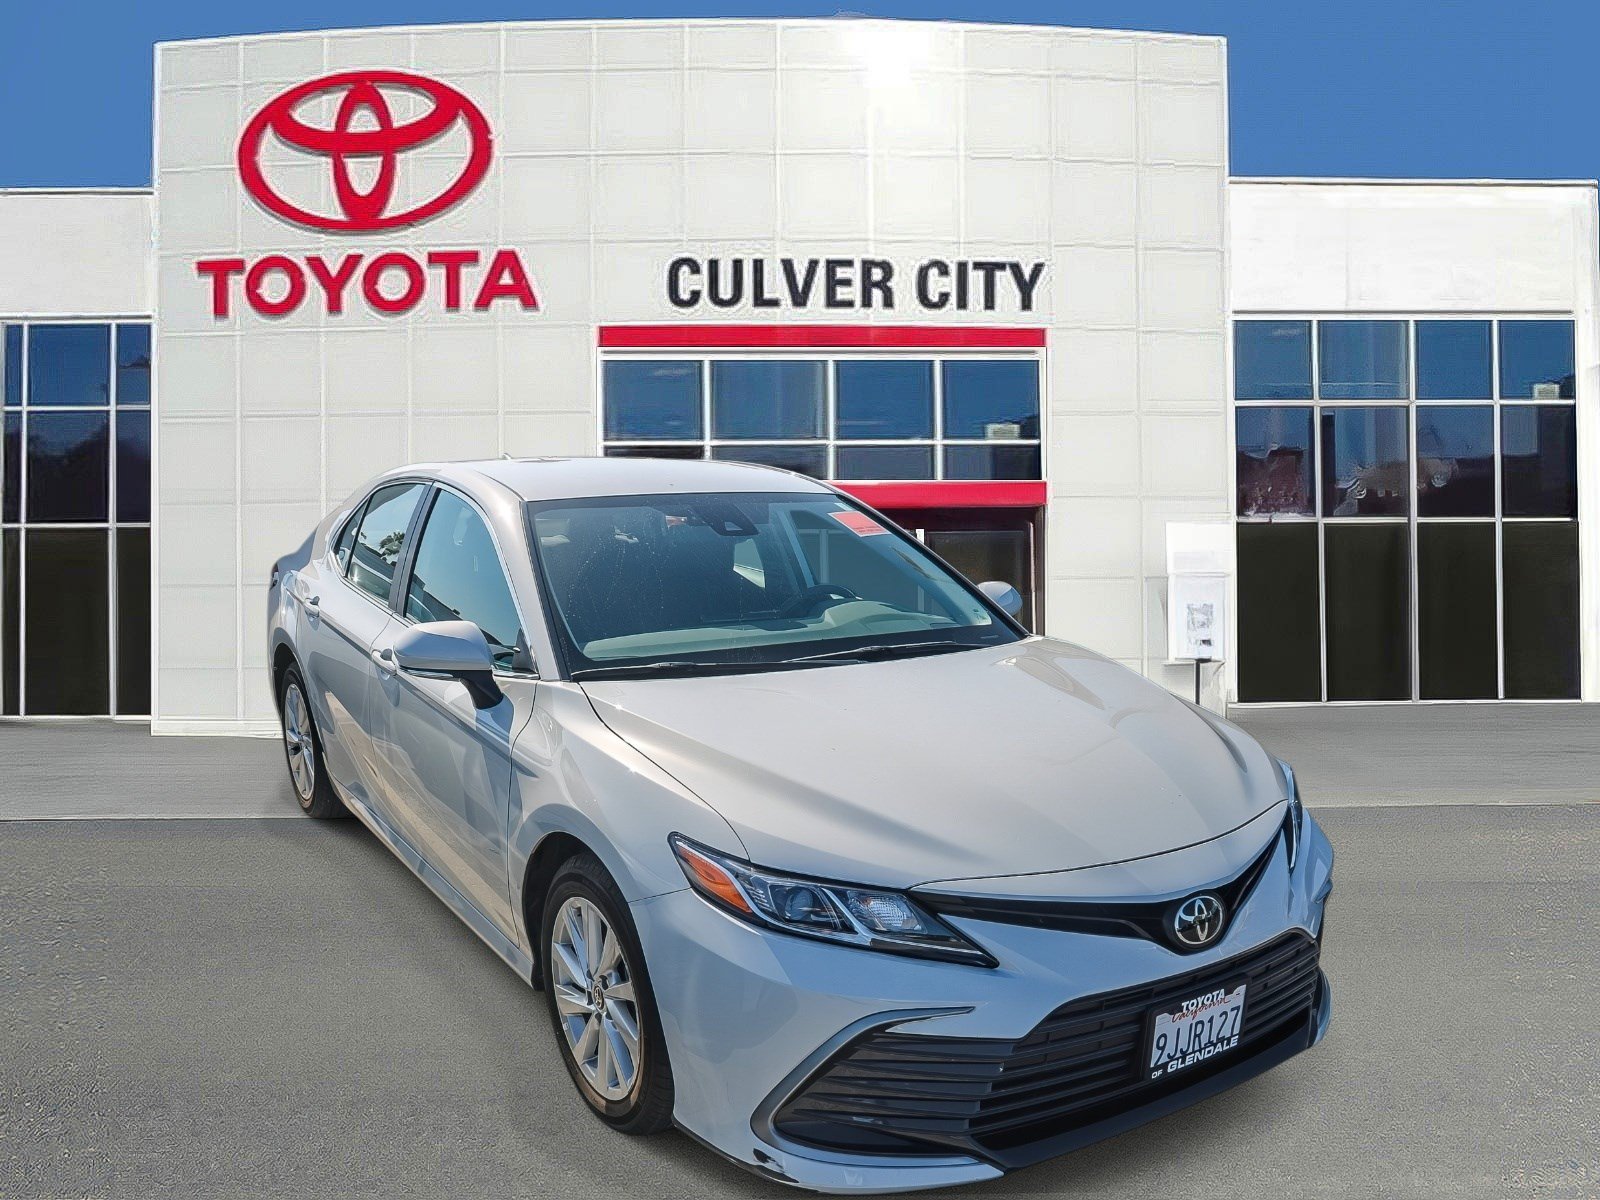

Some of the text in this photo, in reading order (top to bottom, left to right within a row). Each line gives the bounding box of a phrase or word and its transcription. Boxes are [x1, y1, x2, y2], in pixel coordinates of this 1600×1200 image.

[196, 250, 538, 318] TOYOTA
[668, 258, 1045, 311] CULVER CITY
[1182, 988, 1225, 1012] TOYOTA
[1151, 1035, 1239, 1079] OF GLENDALE
[1154, 1005, 1240, 1066] 9JJR127
